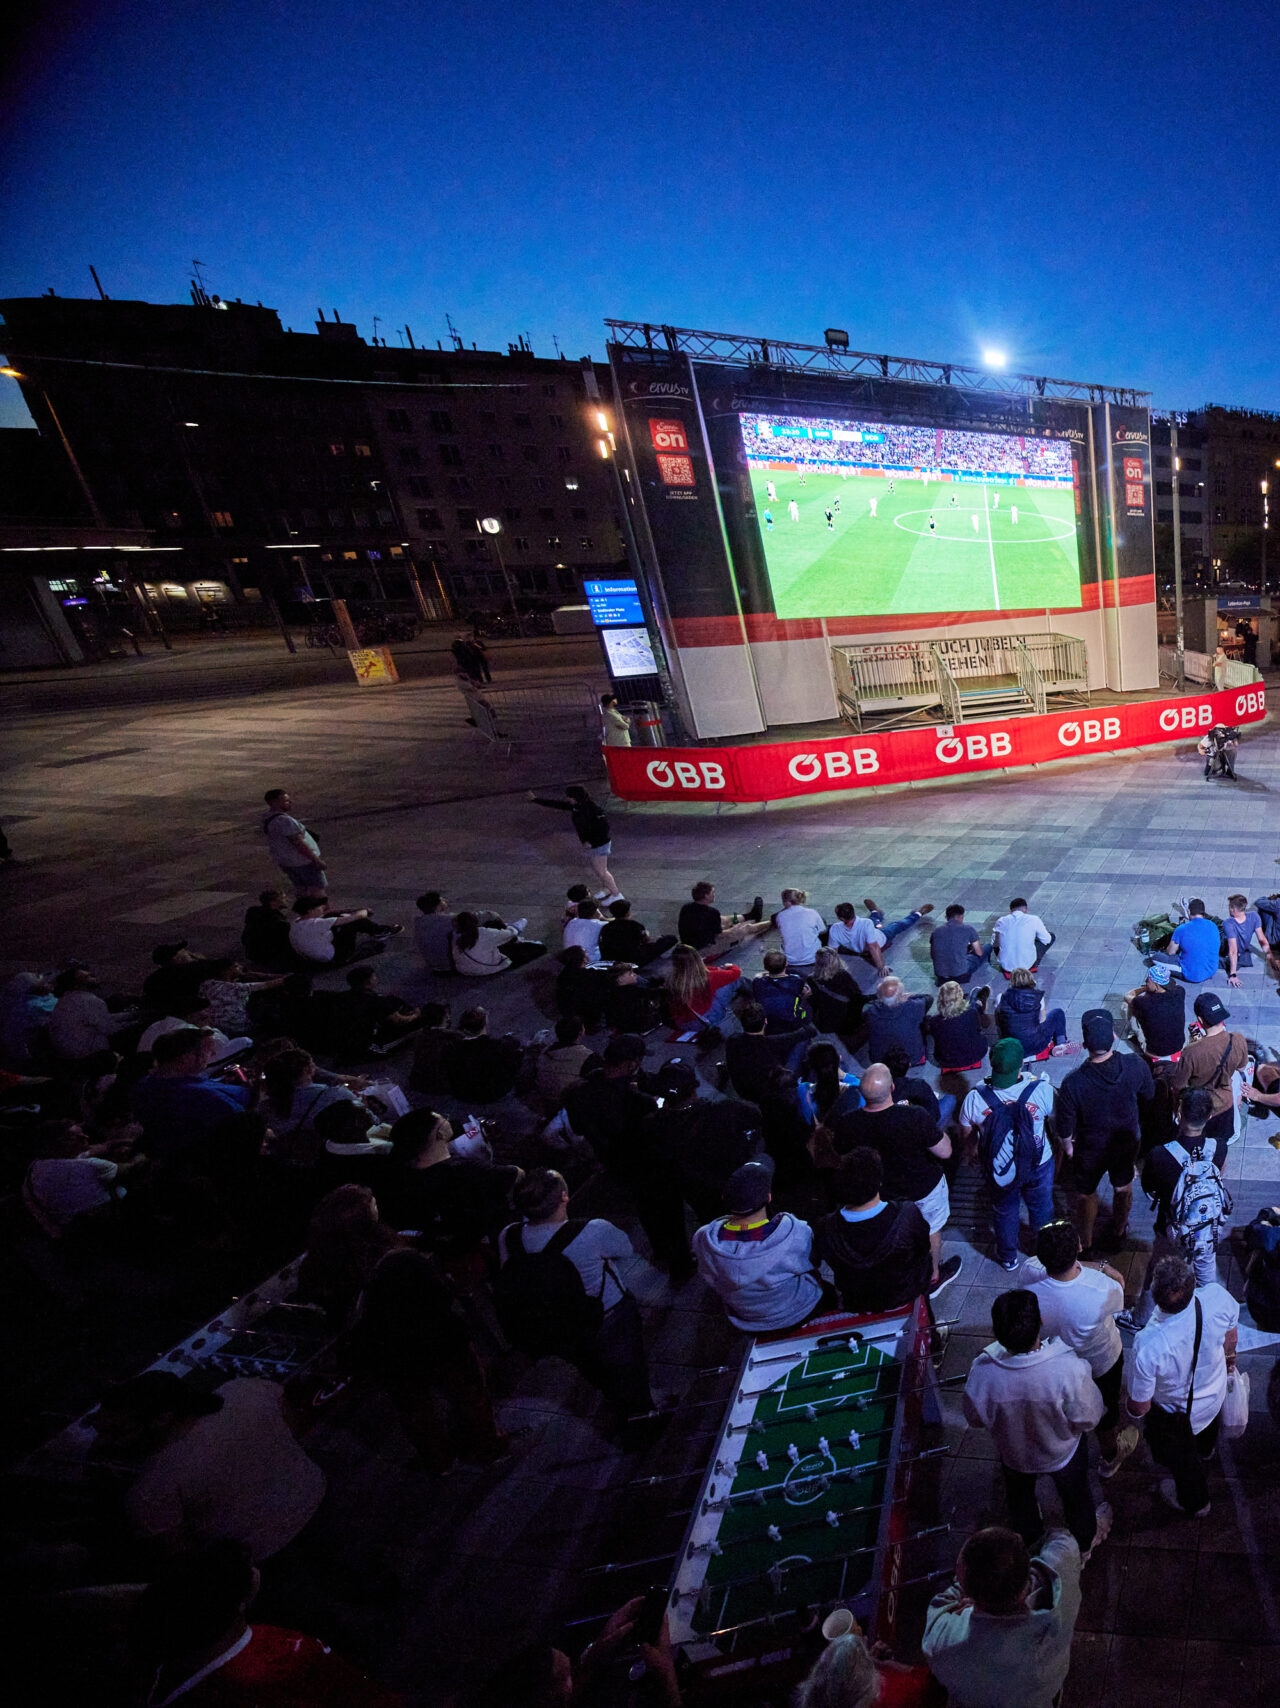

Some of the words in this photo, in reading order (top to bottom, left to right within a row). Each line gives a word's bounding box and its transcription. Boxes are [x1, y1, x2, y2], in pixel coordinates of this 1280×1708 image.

[656, 434, 685, 448] on
[1058, 717, 1121, 747] ÖBB
[1159, 705, 1213, 731] ÖBB
[936, 732, 1012, 764] ÖBB
[646, 760, 726, 790] ÖBB
[788, 749, 880, 782] ÖBB
[992, 1129, 1014, 1175] NIKE
